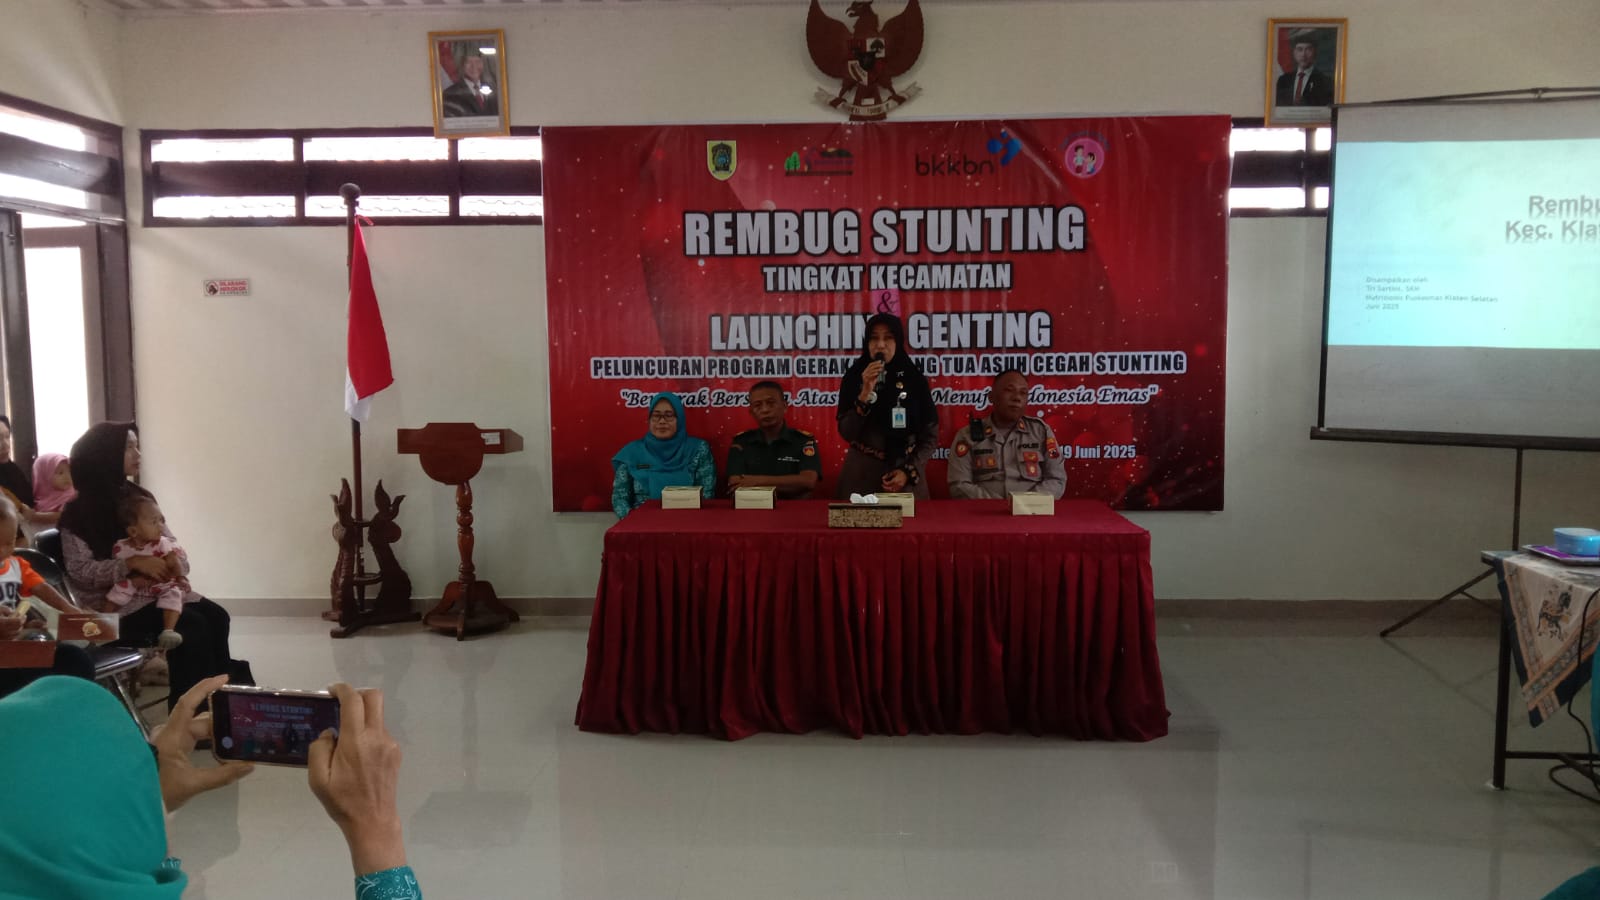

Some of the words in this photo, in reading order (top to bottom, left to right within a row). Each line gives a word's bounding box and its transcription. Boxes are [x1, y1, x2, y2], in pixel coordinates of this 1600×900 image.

[914, 152, 995, 176] bkkbn
[684, 210, 860, 256] REMBUG
[871, 205, 1086, 254] STUNTING
[1505, 220, 1553, 239] Kec.
[1562, 220, 1600, 239] Kla
[763, 265, 864, 291] TINGKAT
[870, 263, 1012, 290] KECAMATAN
[876, 290, 898, 313] &
[711, 315, 873, 350] LAUNCHIN
[908, 312, 1051, 349] GENTING
[592, 358, 702, 377] PELUNCURAN
[707, 357, 790, 376] PROGRAM
[795, 357, 854, 376] GERAK
[942, 356, 976, 374] TUA
[980, 355, 1027, 374] ASUH
[1033, 355, 1090, 373] CEGAH
[1096, 353, 1185, 372] STUNTING
[795, 389, 838, 406] Atas
[932, 388, 991, 409] Menuj
[1028, 387, 1094, 404] donesia
[1074, 445, 1100, 459] Juni
[1103, 444, 1137, 459] 2025
